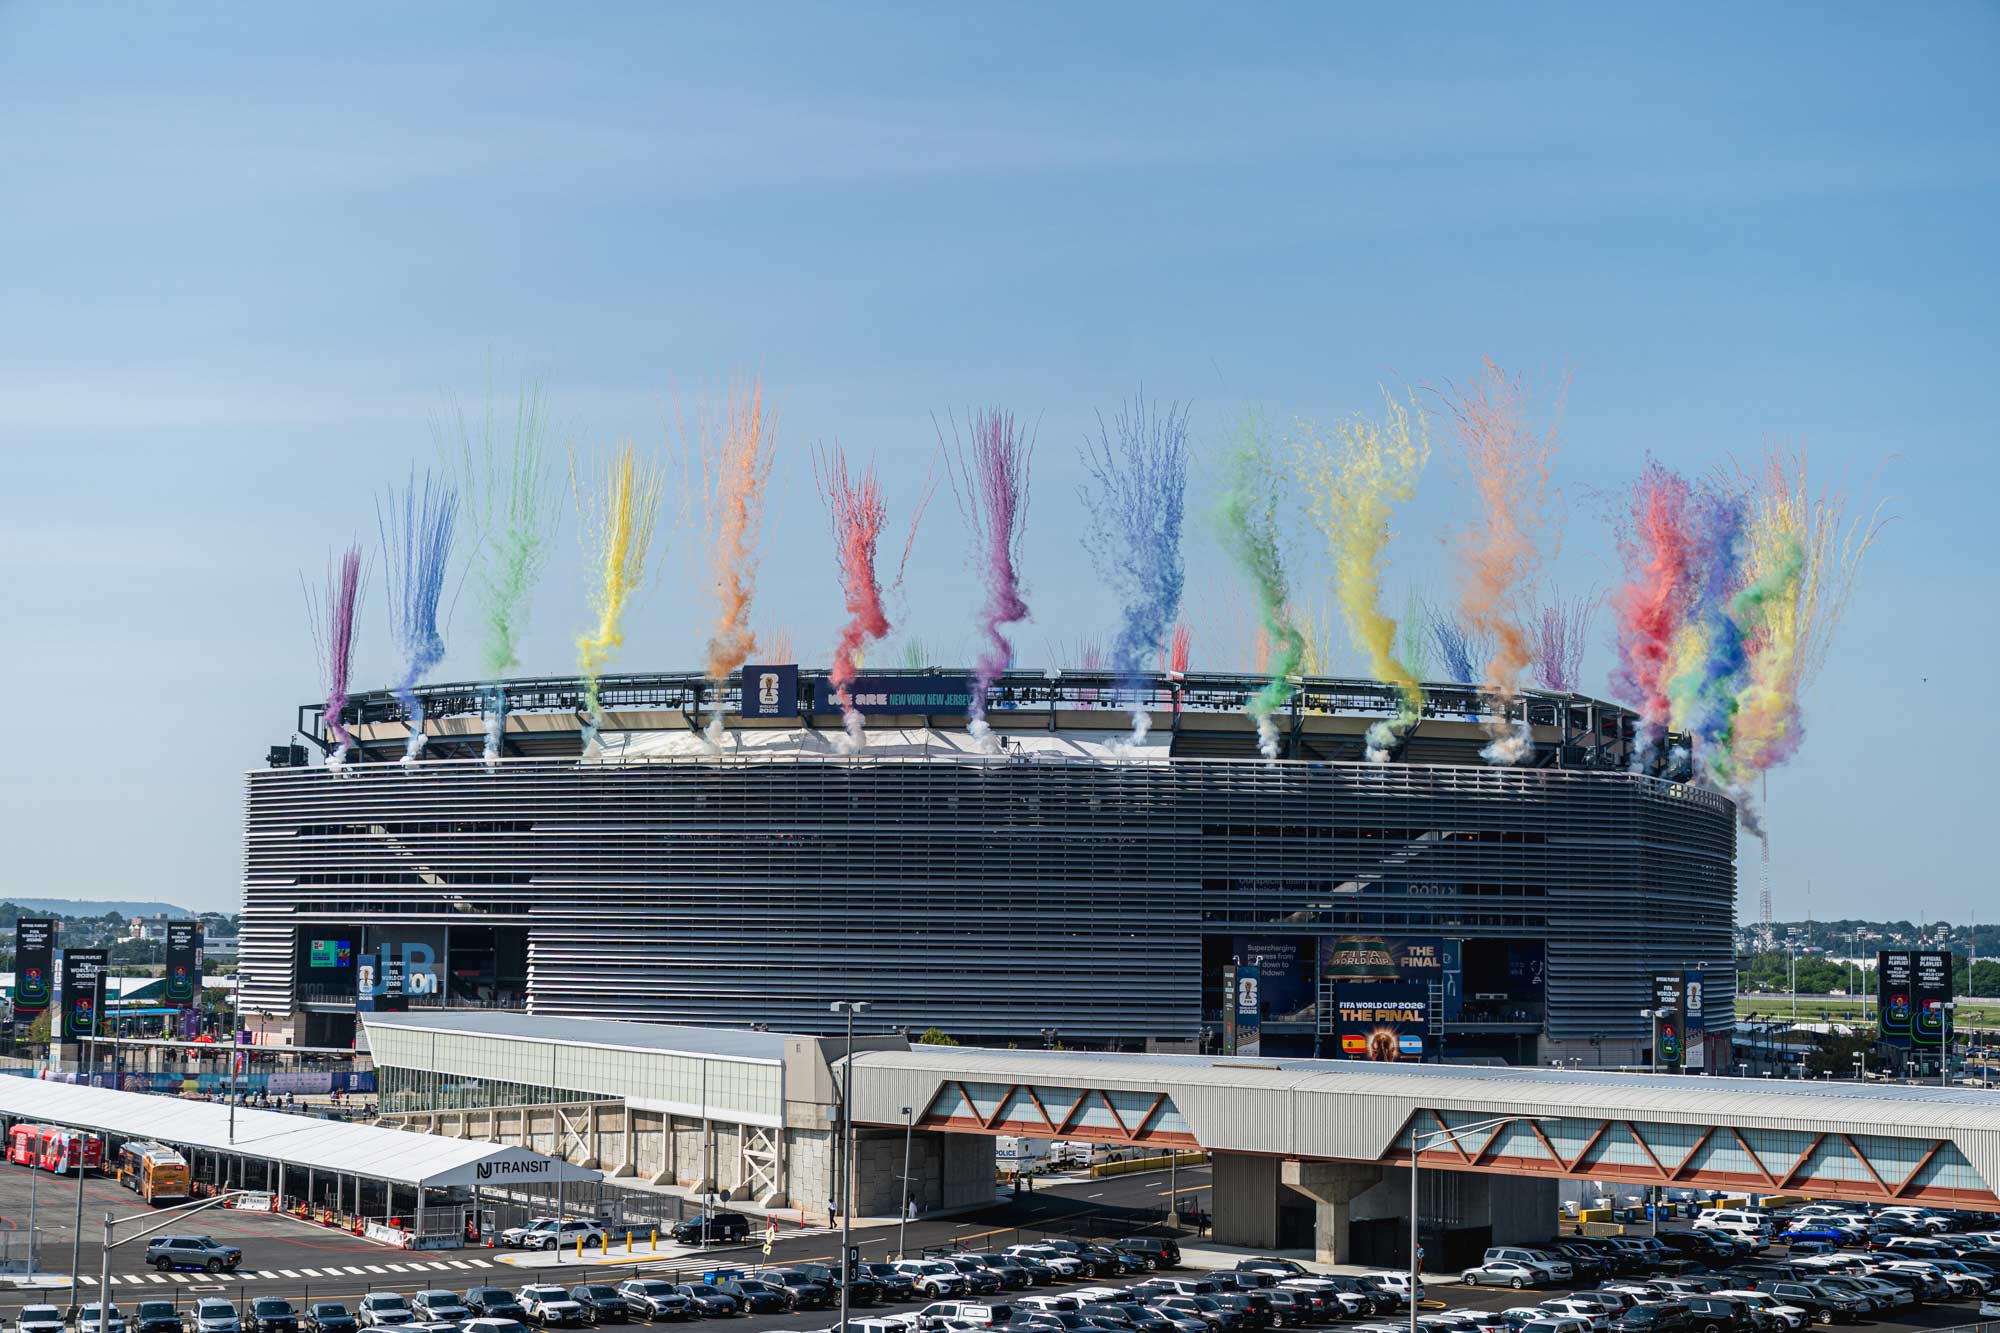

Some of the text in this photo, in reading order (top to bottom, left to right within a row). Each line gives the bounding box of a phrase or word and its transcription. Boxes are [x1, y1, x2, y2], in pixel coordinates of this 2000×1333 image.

[889, 694, 907, 705] NEW
[907, 694, 926, 705] YORK
[927, 694, 944, 705] NEW
[945, 694, 973, 705] JERSEY
[1247, 944, 1296, 952] Supercharging
[1408, 946, 1434, 956] THE
[1334, 957, 1390, 965] WORLD CUP
[1400, 957, 1441, 967] FINAL
[1339, 1010, 1425, 1022] THE FINAL
[493, 1160, 551, 1174] TRANSIT
[851, 1249, 857, 1260] D
[851, 1268, 856, 1280] 3
